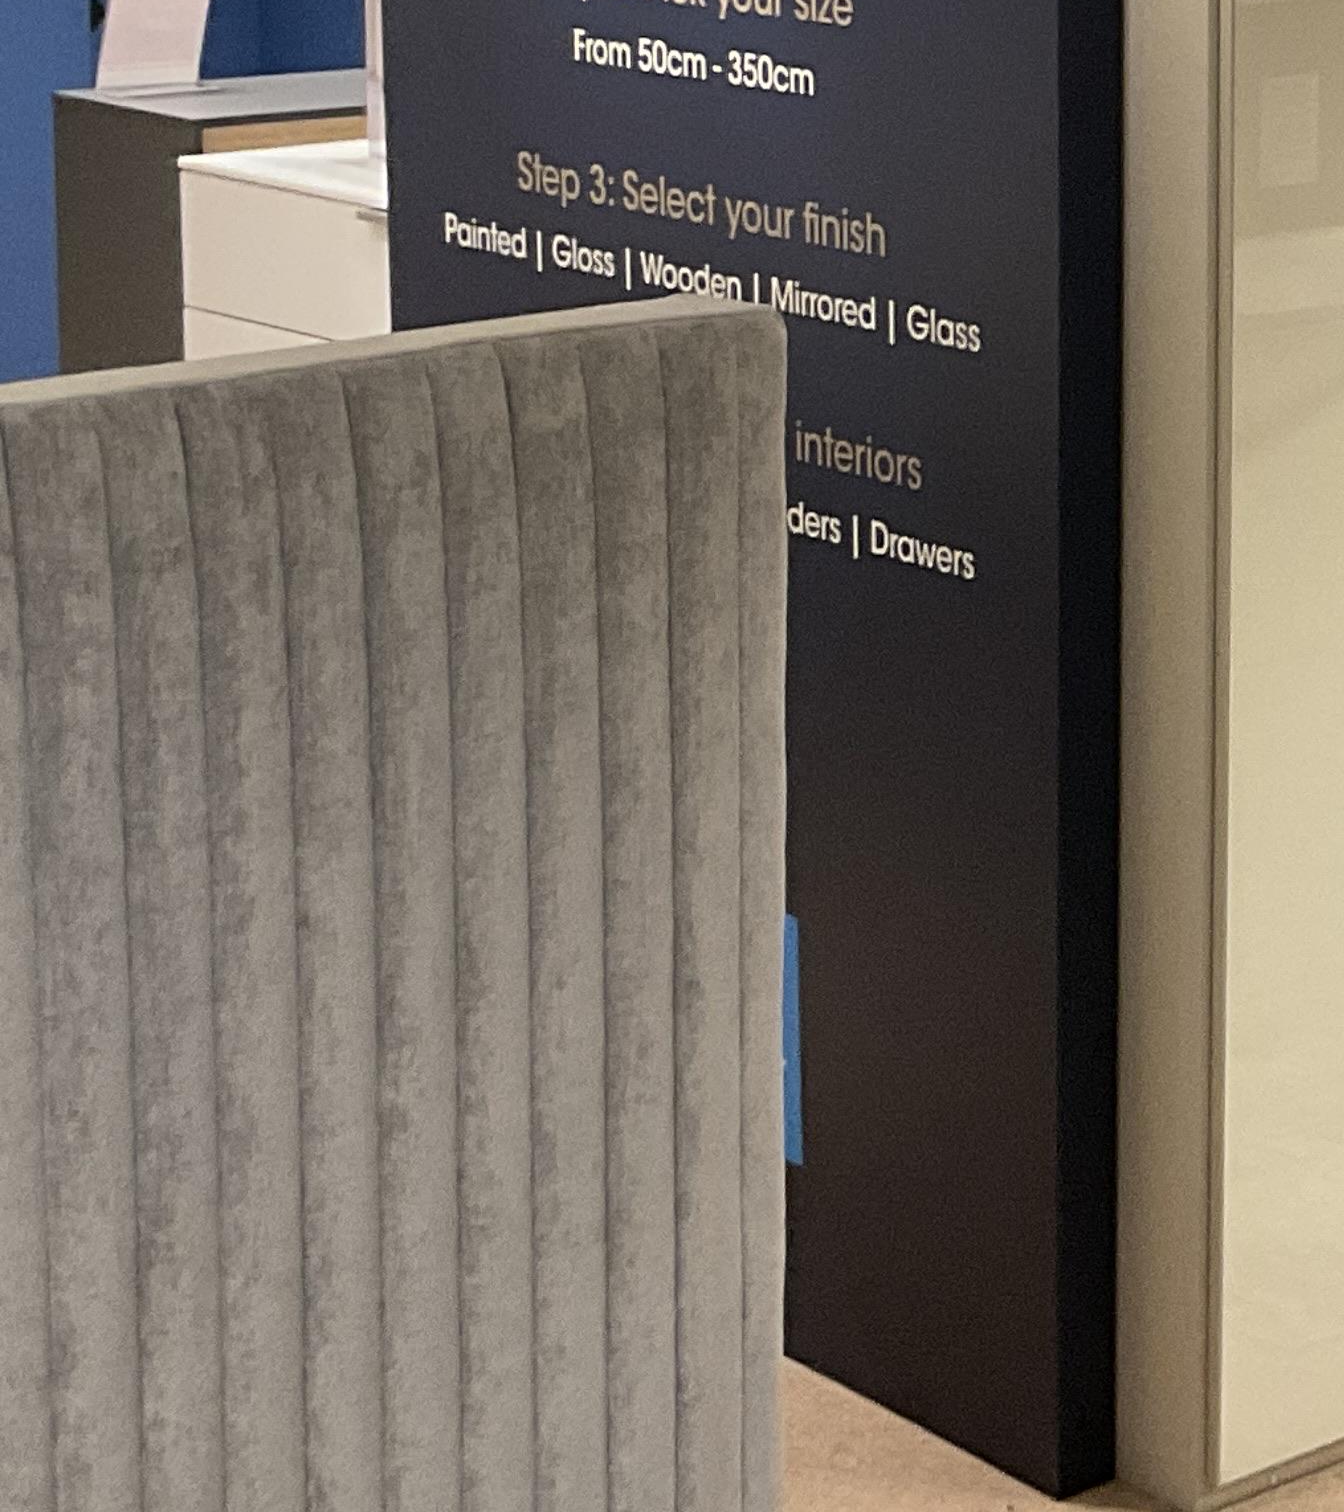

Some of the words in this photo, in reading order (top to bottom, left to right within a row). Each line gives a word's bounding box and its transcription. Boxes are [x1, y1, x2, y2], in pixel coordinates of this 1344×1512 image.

[573, 27, 631, 70] From
[638, 37, 706, 81] 50cm
[728, 49, 814, 96] 350cm
[518, 151, 580, 207] Step
[589, 163, 615, 206] 3:
[623, 170, 716, 226] Select
[725, 197, 795, 240] your
[803, 202, 886, 258] finish
[444, 211, 527, 259] Painted
[553, 236, 615, 278] Gloss
[640, 251, 742, 301] Wooden
[771, 276, 876, 331] Mirrored
[907, 305, 981, 353] Glass
[796, 420, 923, 490] interiors
[787, 501, 842, 544] ders
[871, 519, 976, 579] Drawers
